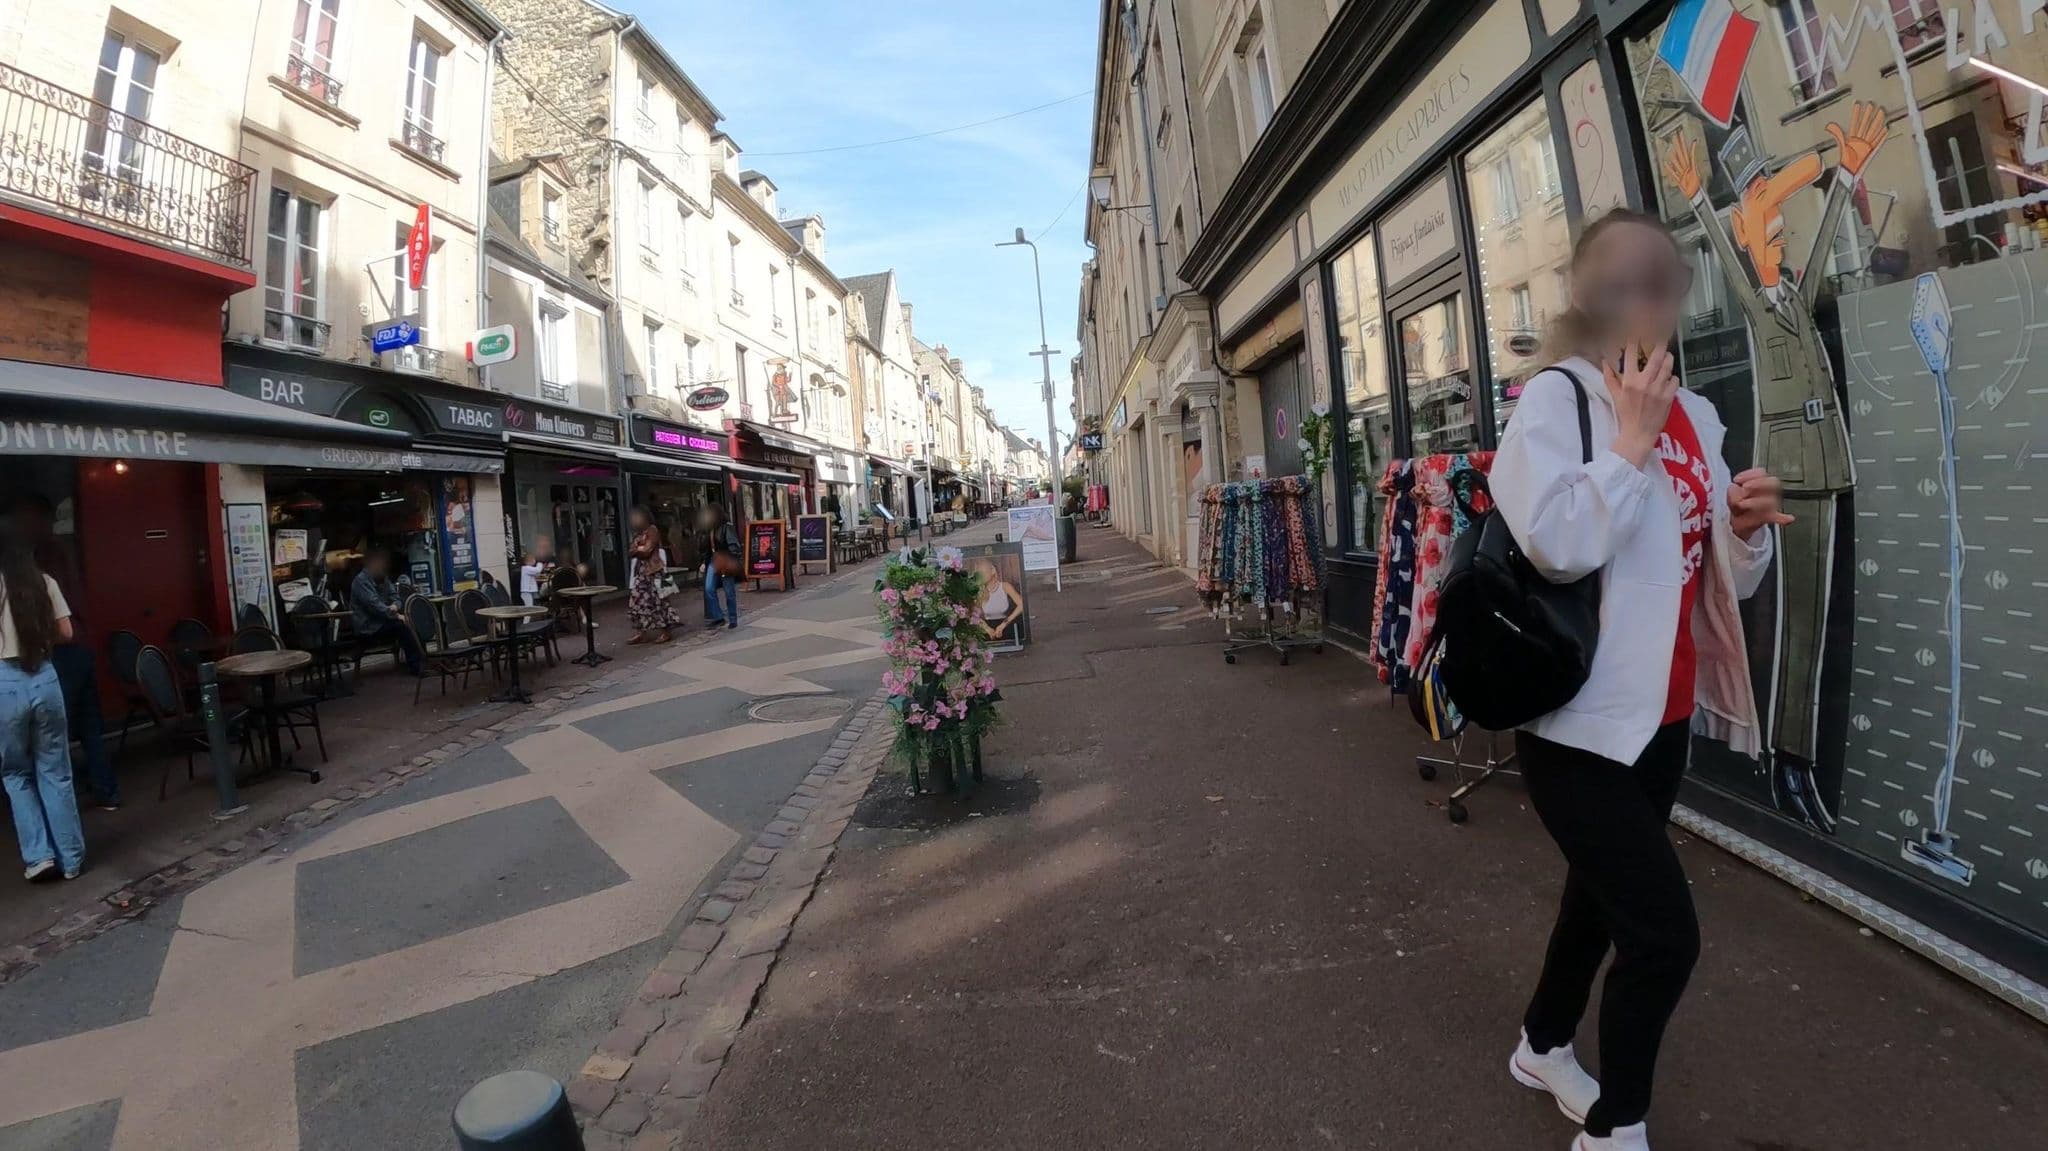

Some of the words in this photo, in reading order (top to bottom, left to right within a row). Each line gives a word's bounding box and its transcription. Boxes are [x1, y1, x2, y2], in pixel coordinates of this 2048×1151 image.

[1396, 63, 1471, 150] CAPRICES
[412, 222, 425, 271] TABAC
[378, 327, 397, 341] FDJ
[260, 378, 304, 405] BAR
[448, 406, 493, 428] TABAC
[535, 411, 554, 433] Mon
[554, 414, 585, 437] Univers
[0, 420, 189, 456] ONTMARTRE
[1085, 435, 1100, 446] NK
